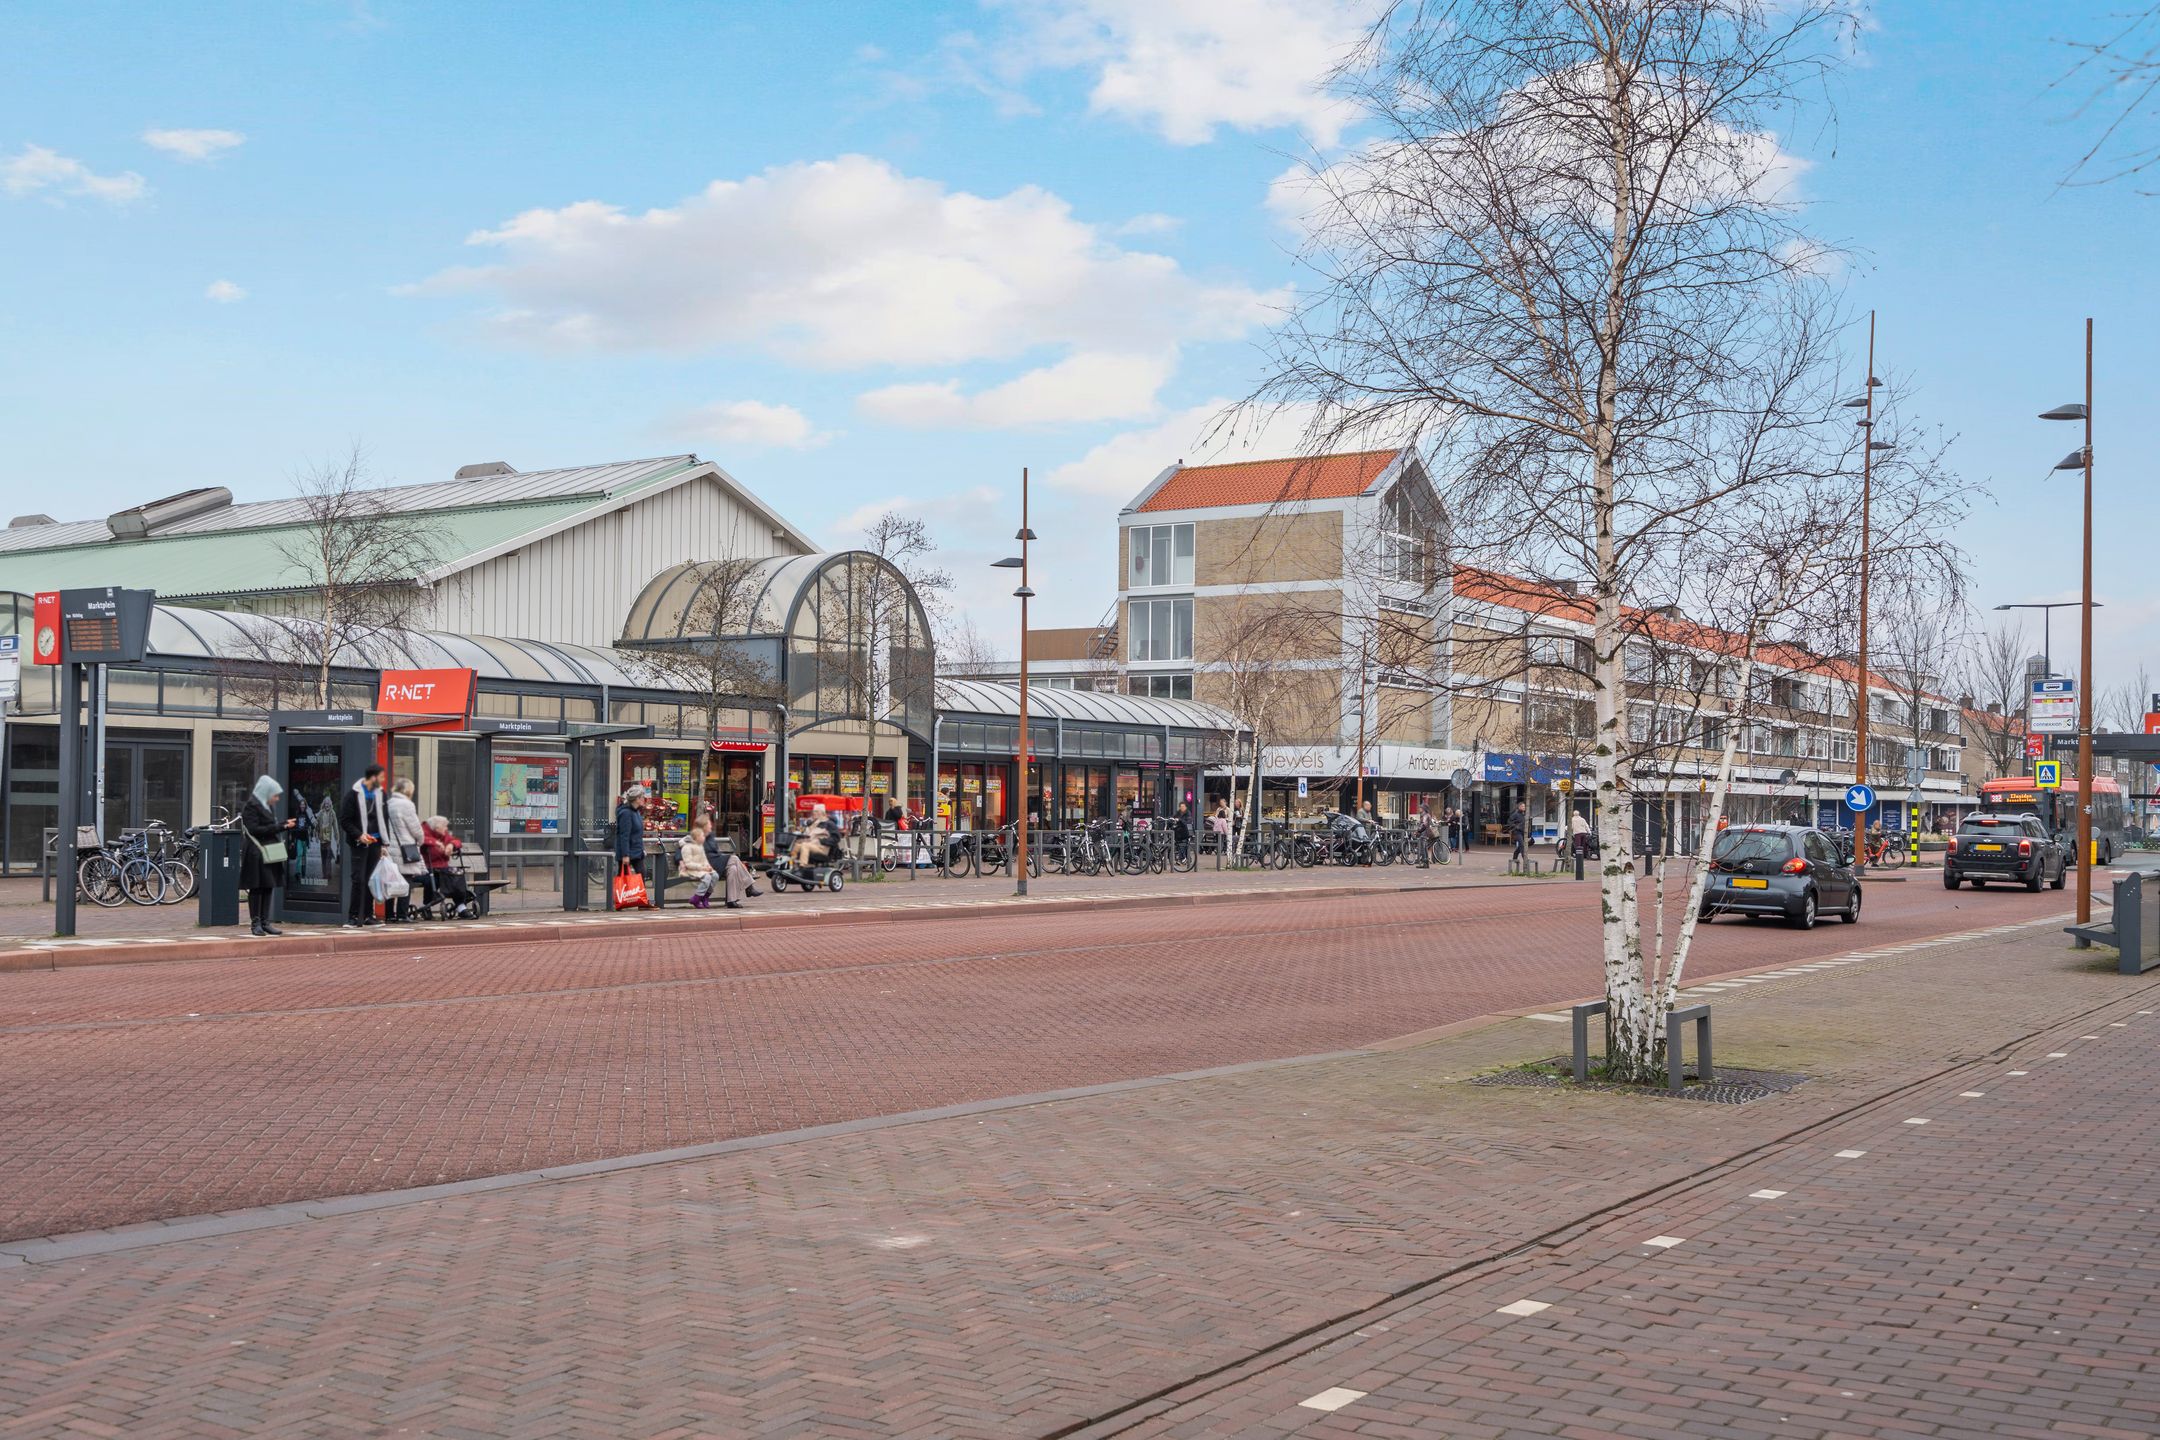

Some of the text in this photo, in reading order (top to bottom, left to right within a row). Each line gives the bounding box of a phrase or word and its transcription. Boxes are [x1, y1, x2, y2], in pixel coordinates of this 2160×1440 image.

[88, 602, 115, 610] Marktplein
[328, 714, 353, 722] Marktplein
[499, 722, 532, 731] Marktplein
